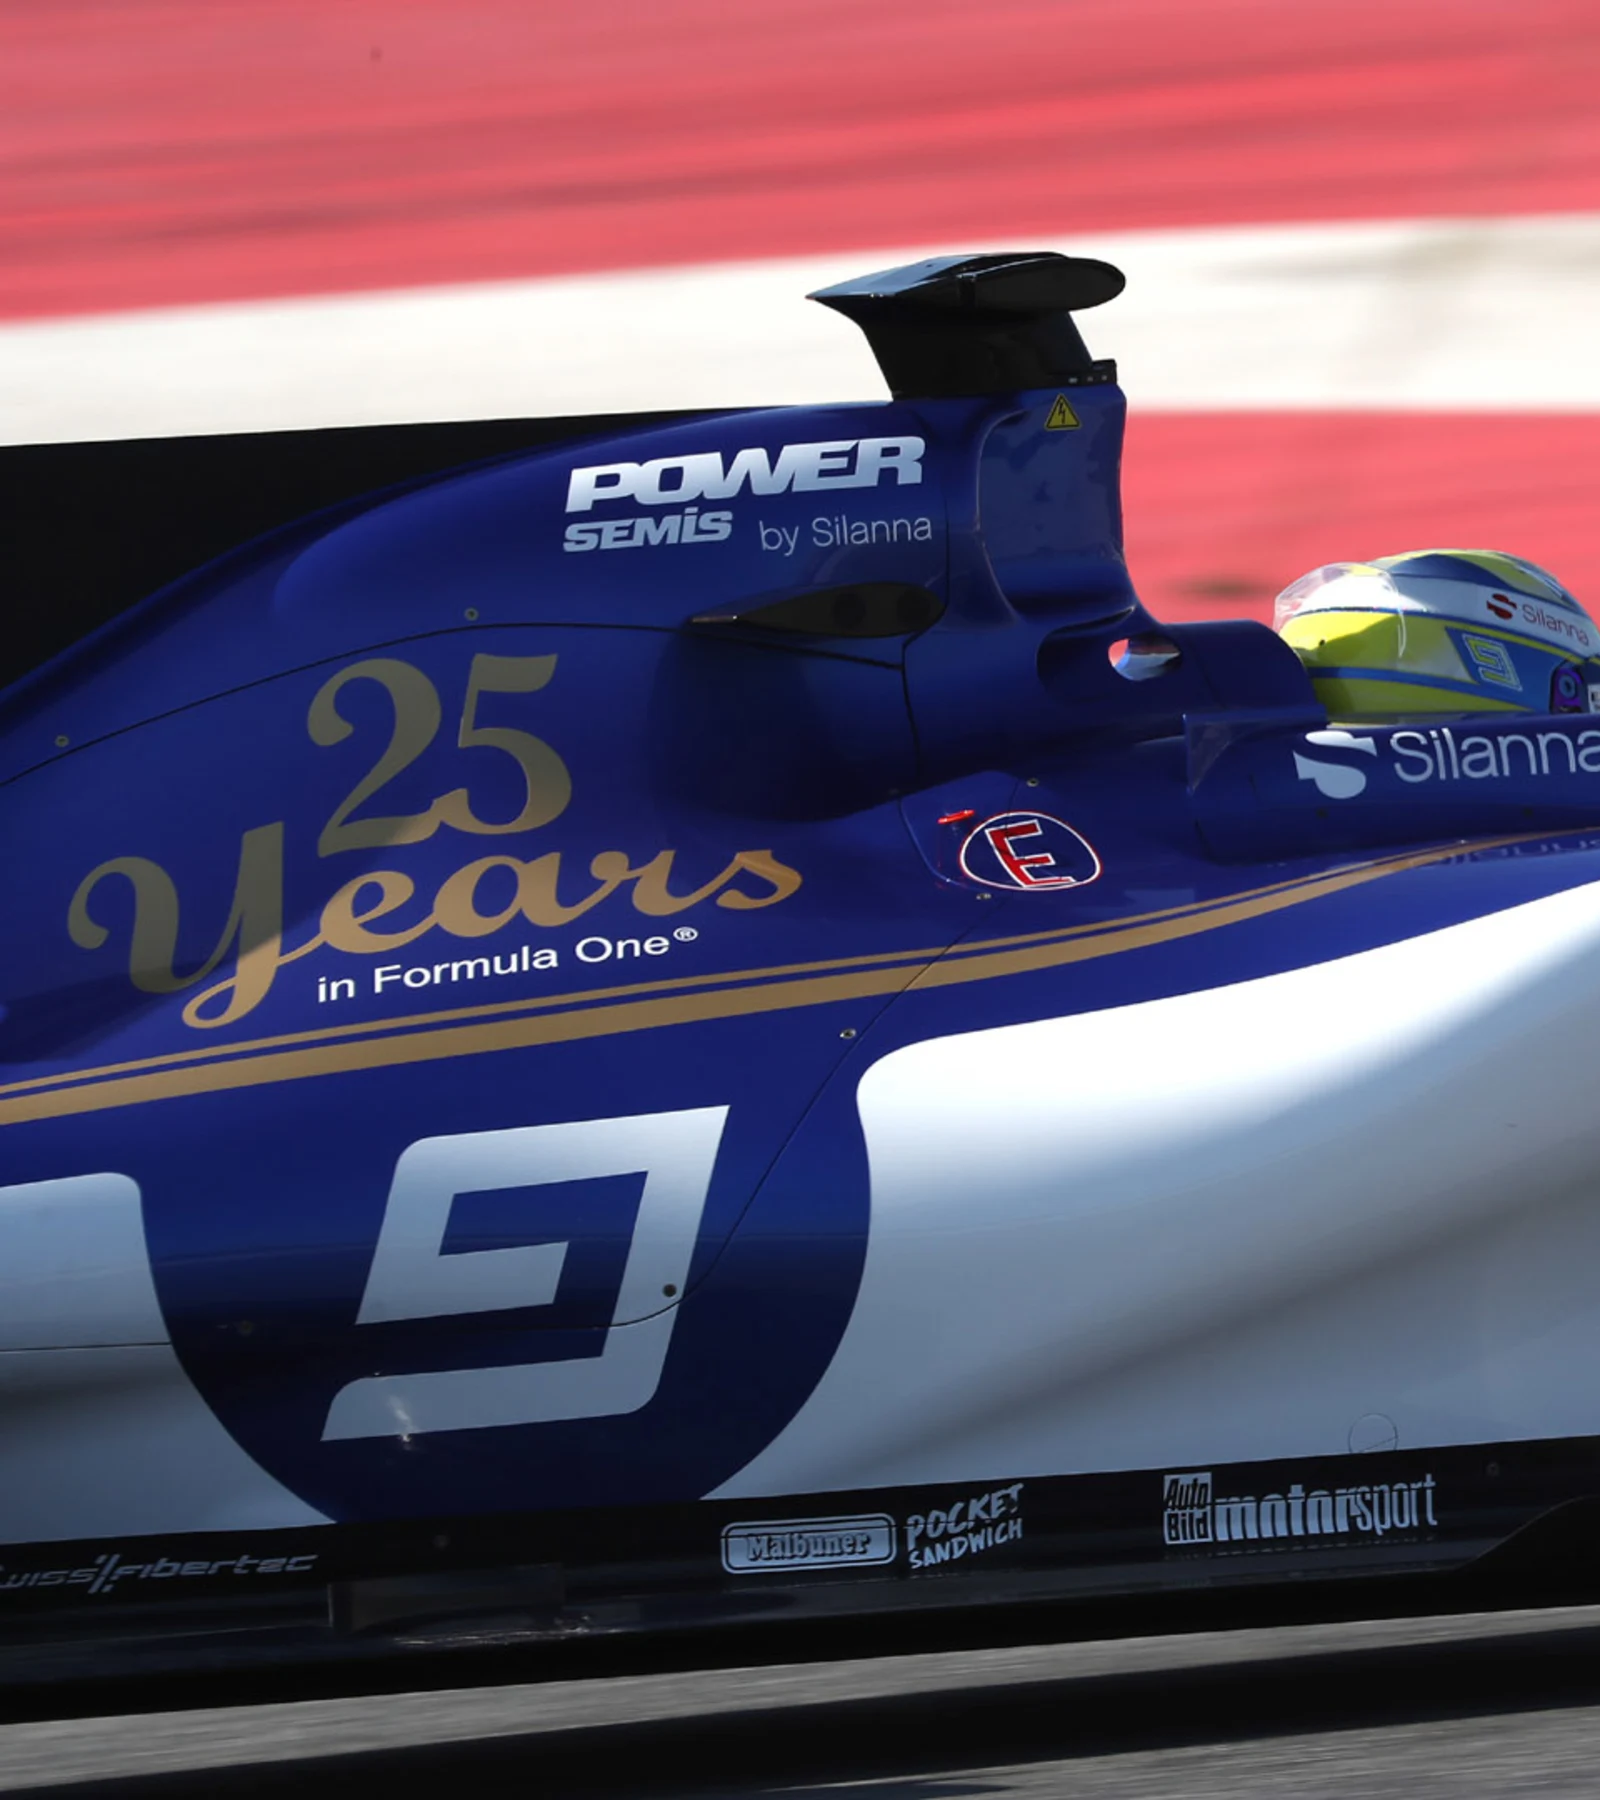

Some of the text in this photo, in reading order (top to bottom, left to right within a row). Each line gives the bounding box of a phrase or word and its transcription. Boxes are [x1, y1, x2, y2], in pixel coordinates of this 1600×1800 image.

[565, 436, 926, 513] POWER
[759, 515, 932, 556] by Silanna
[1522, 604, 1590, 646] Silanna
[307, 653, 572, 858] 25
[985, 819, 1077, 888] E
[67, 820, 803, 1029] Years
[317, 974, 355, 1003] in
[372, 945, 558, 994] Formula
[320, 1104, 731, 1442] 9
[905, 1482, 1025, 1552] POCKET
[1165, 1477, 1209, 1512] Auto
[1213, 1473, 1438, 1542] motorsport
[745, 1531, 871, 1562] Malbuner
[908, 1516, 1024, 1570] SANDWICH
[1167, 1510, 1210, 1542] Bild
[0, 1564, 98, 1589] wiss
